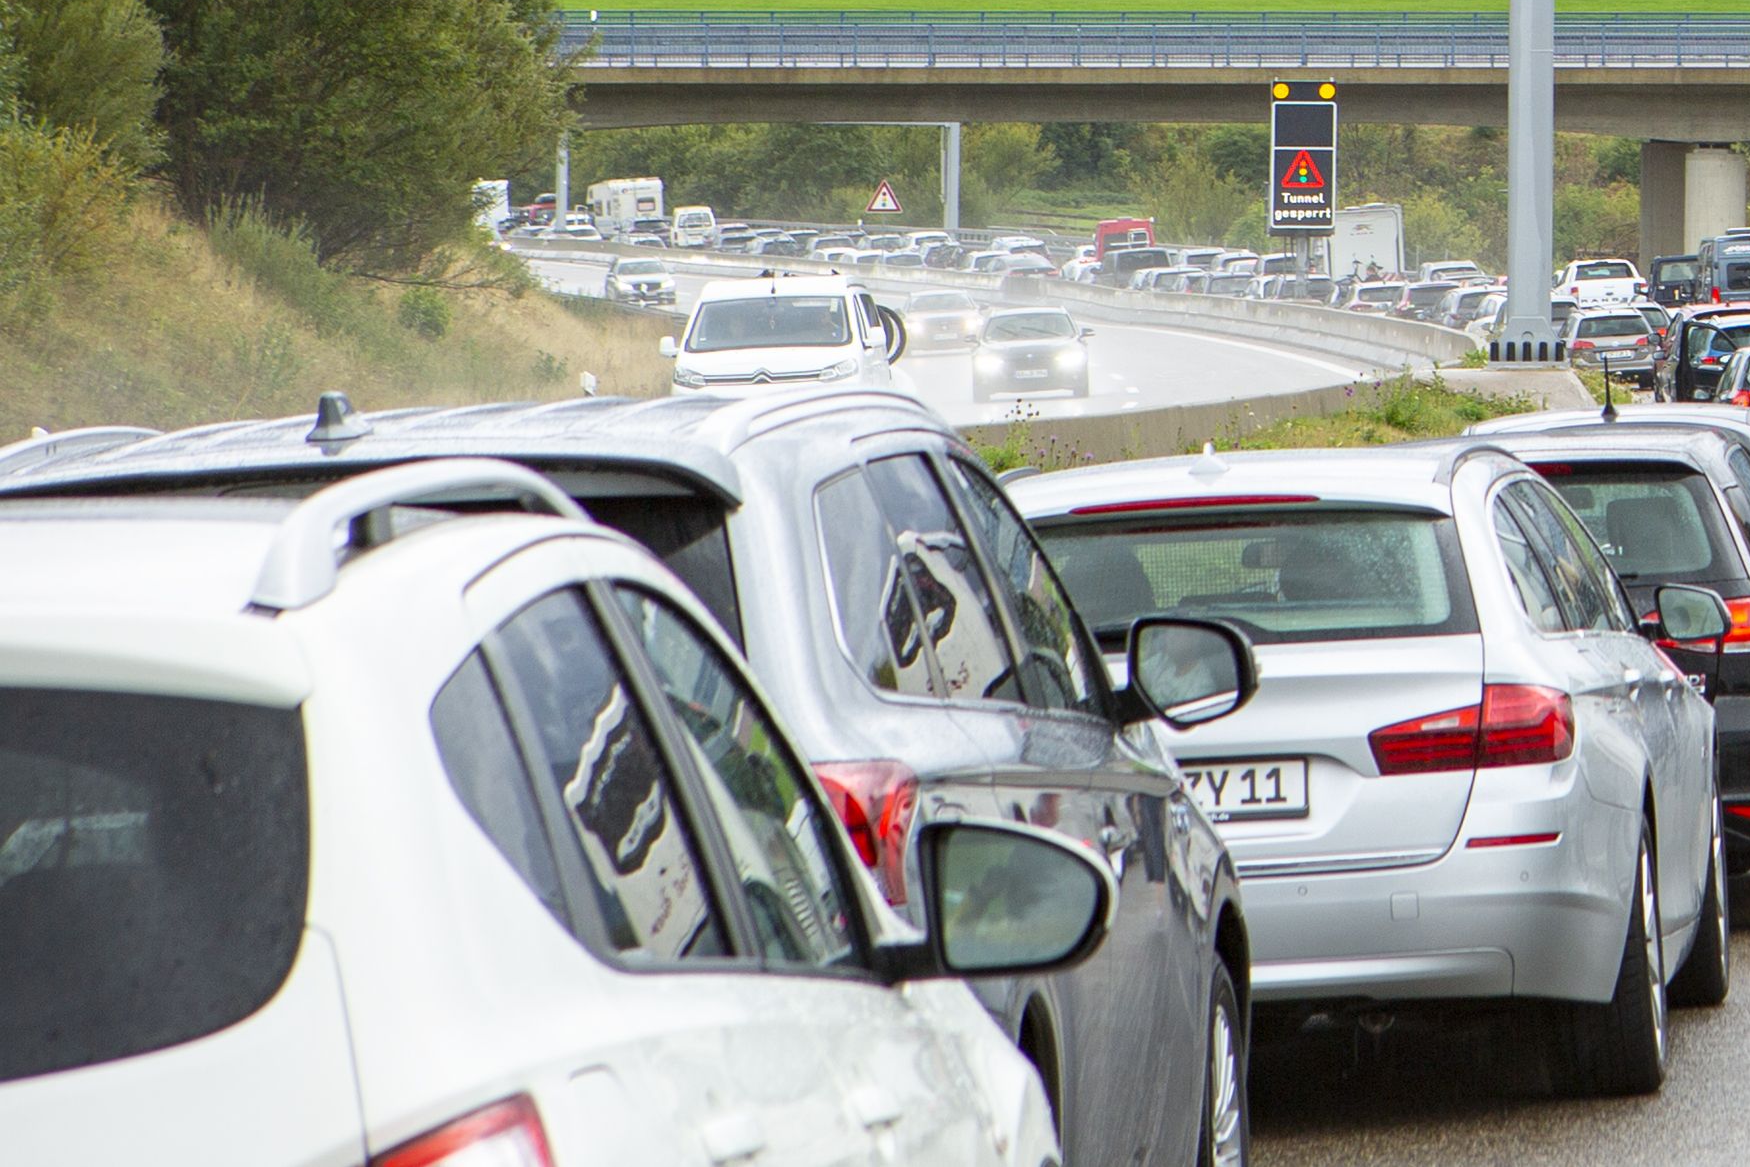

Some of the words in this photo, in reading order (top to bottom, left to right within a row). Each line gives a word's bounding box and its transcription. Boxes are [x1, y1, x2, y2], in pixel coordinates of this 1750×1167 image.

[1281, 192, 1325, 204] Tunnel
[1274, 207, 1332, 221] gesperrt
[1240, 767, 1287, 804] 11
